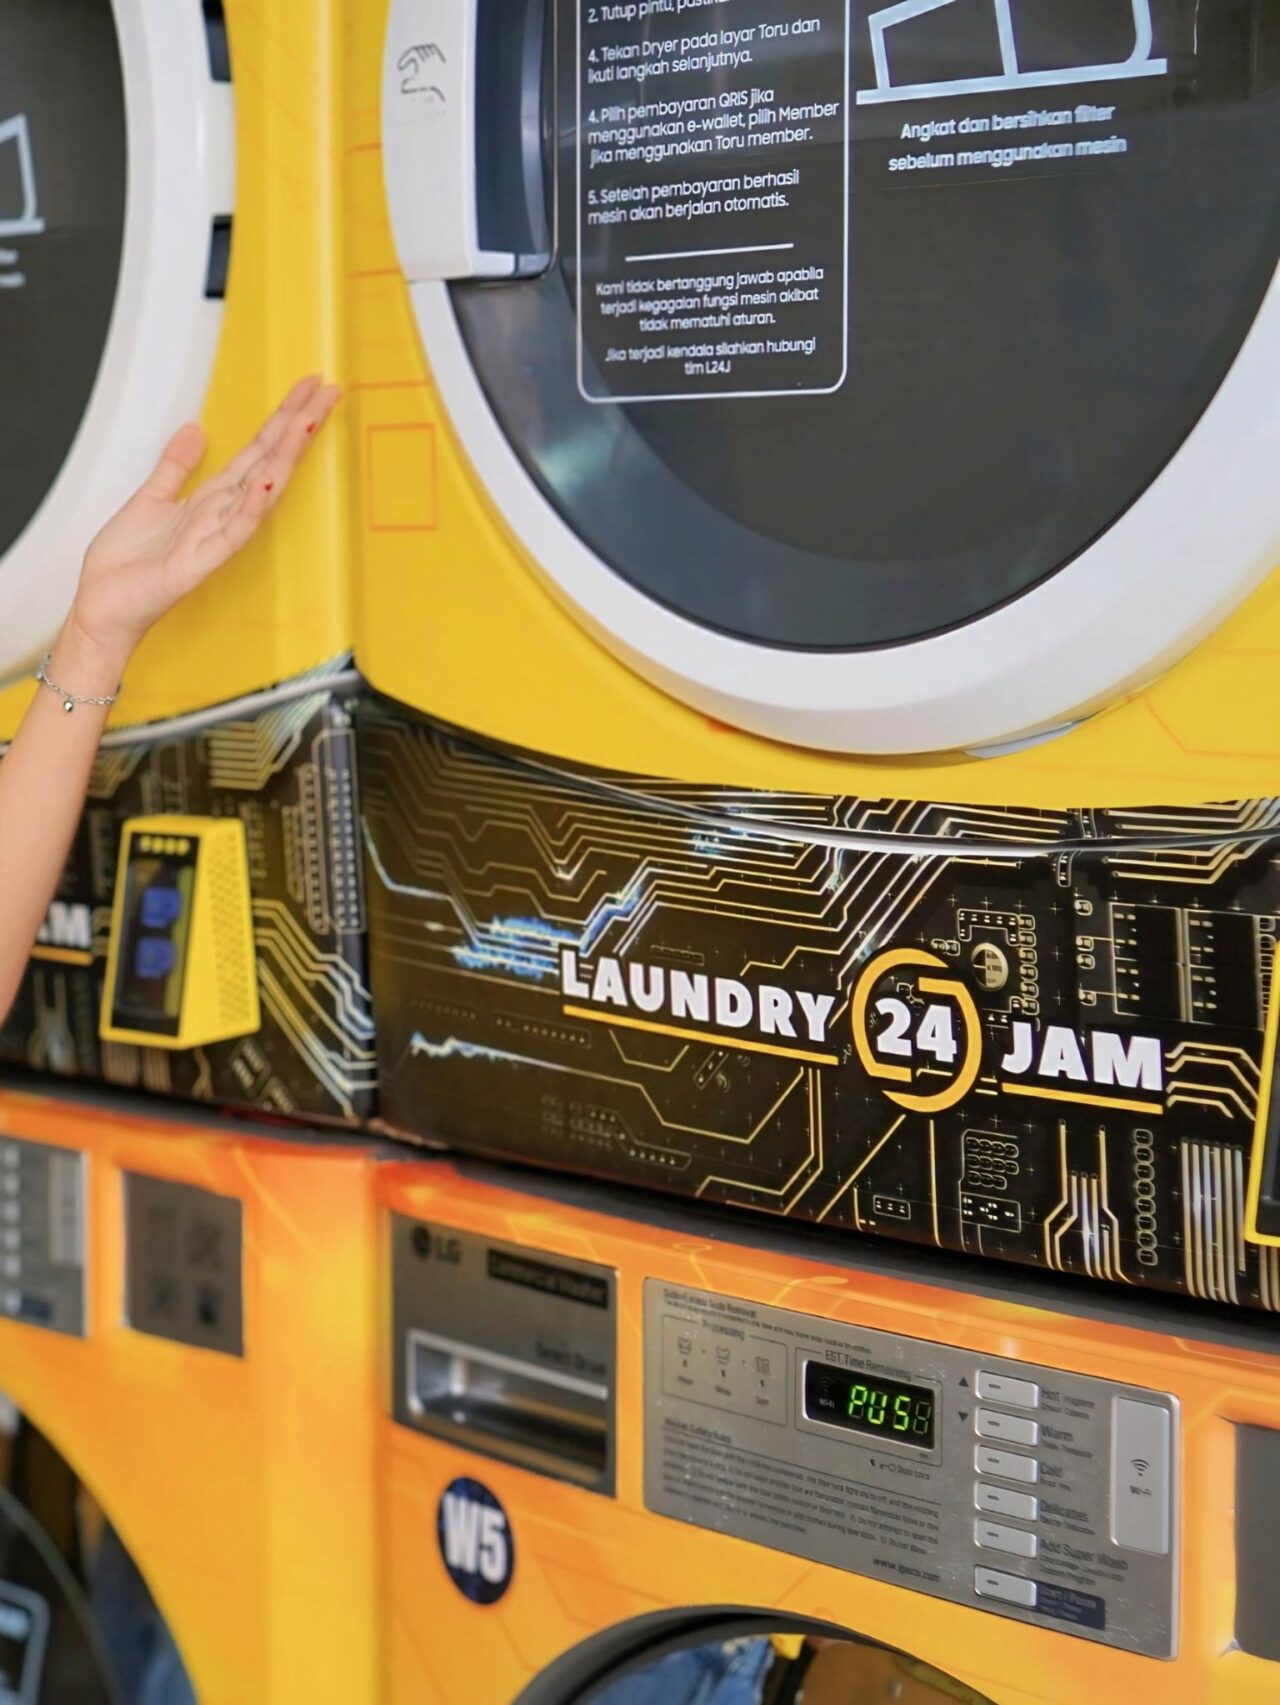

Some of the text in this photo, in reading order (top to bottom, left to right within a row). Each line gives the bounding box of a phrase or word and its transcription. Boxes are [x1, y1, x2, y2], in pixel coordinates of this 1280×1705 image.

[601, 6, 636, 21] Tutup
[588, 18, 820, 62] 4. Tekan Dryer pada layar Toru dan
[616, 58, 669, 82] langkah
[672, 50, 752, 73] selanjutnya.
[588, 88, 774, 124] 4. Pilih pembayaran QRIS jika
[588, 102, 839, 145] menggunakan e-wallet, pilih Member
[900, 119, 956, 142] Angkat
[958, 117, 990, 134] dan
[992, 110, 1071, 131] bersihkan
[615, 133, 712, 162] menggunakan
[716, 136, 744, 151] Toru
[747, 126, 813, 147] member.
[889, 135, 1127, 171] sebelum menggunakan mesin
[600, 184, 649, 204] Setelah
[651, 176, 740, 203] pembayaran
[744, 169, 799, 189] berhasil
[588, 194, 789, 224] mesin akan berjalan otomatis.
[596, 266, 824, 296] Kami tidak bertanggung jawab apabila
[601, 287, 819, 317] terjadi kegagalan fungsi mesin akibat
[639, 310, 776, 332] tidak mematuhi aturan.
[629, 344, 665, 363] terjadi
[667, 340, 714, 359] kendala
[716, 342, 765, 356] silahkan
[766, 336, 816, 355] hubungi
[706, 361, 731, 374] L24J
[561, 950, 1164, 1091] LAUNDRY 24 JAM
[435, 1234, 461, 1265] LG
[442, 1491, 508, 1584] W5
